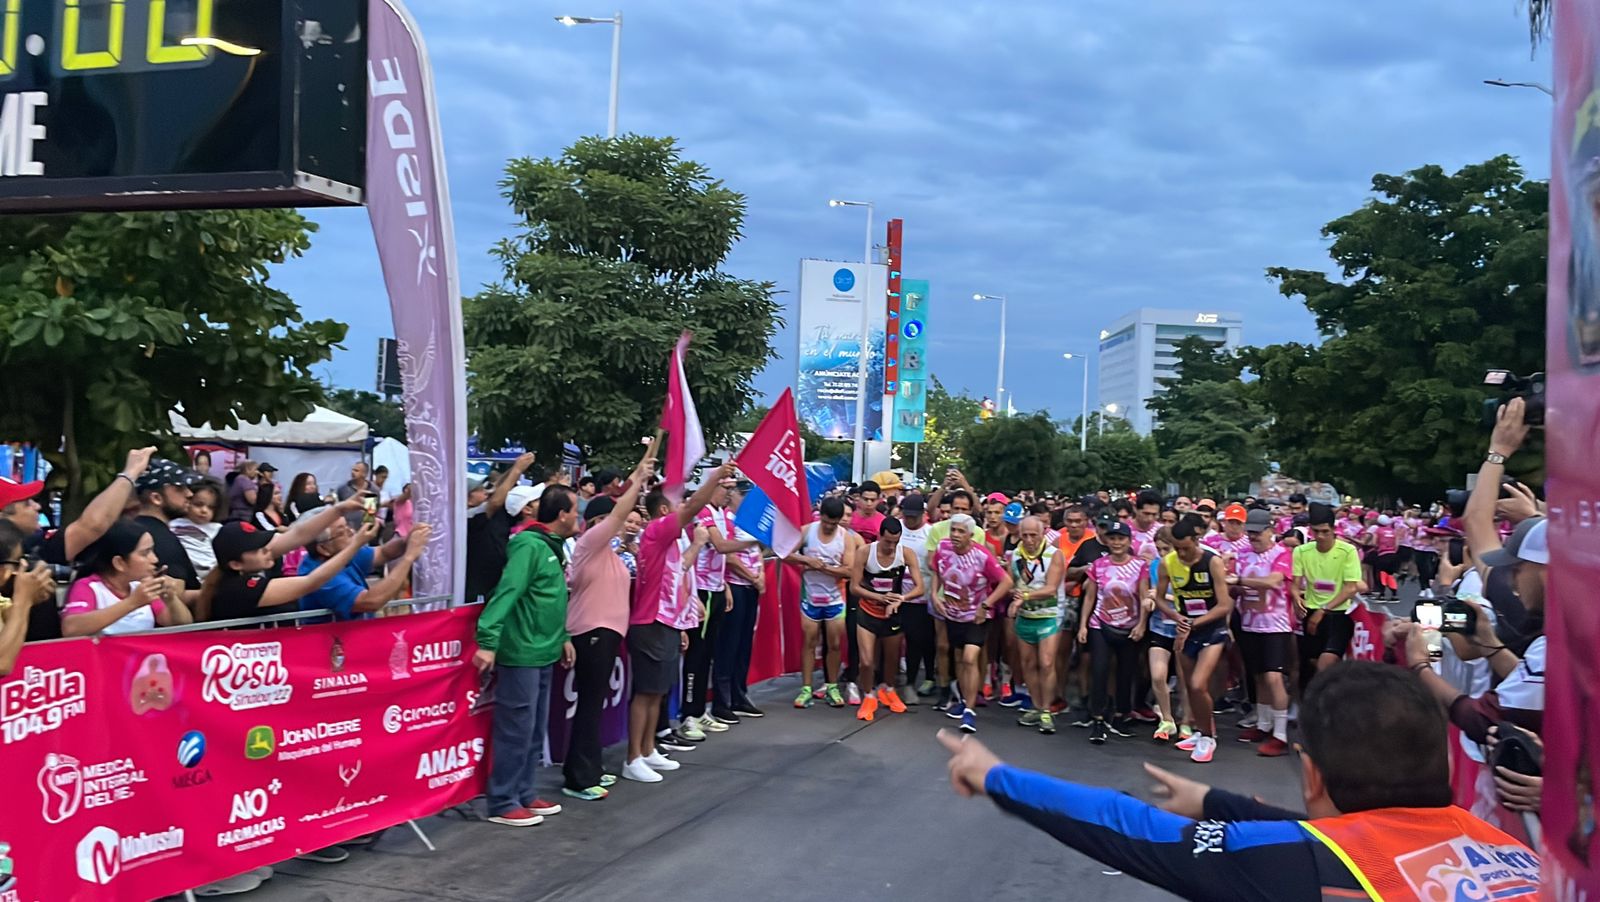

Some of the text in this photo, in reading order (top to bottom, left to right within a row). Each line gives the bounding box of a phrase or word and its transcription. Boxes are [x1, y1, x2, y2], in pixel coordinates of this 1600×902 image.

[412, 640, 461, 664] SALUD
[205, 649, 285, 701] Rosa
[313, 673, 368, 690] SINALOA
[3, 669, 85, 720] Bella
[1, 700, 86, 744] 104.9 FM
[279, 718, 362, 747] JOHN DEERE
[217, 816, 286, 847] FARMACIAS
